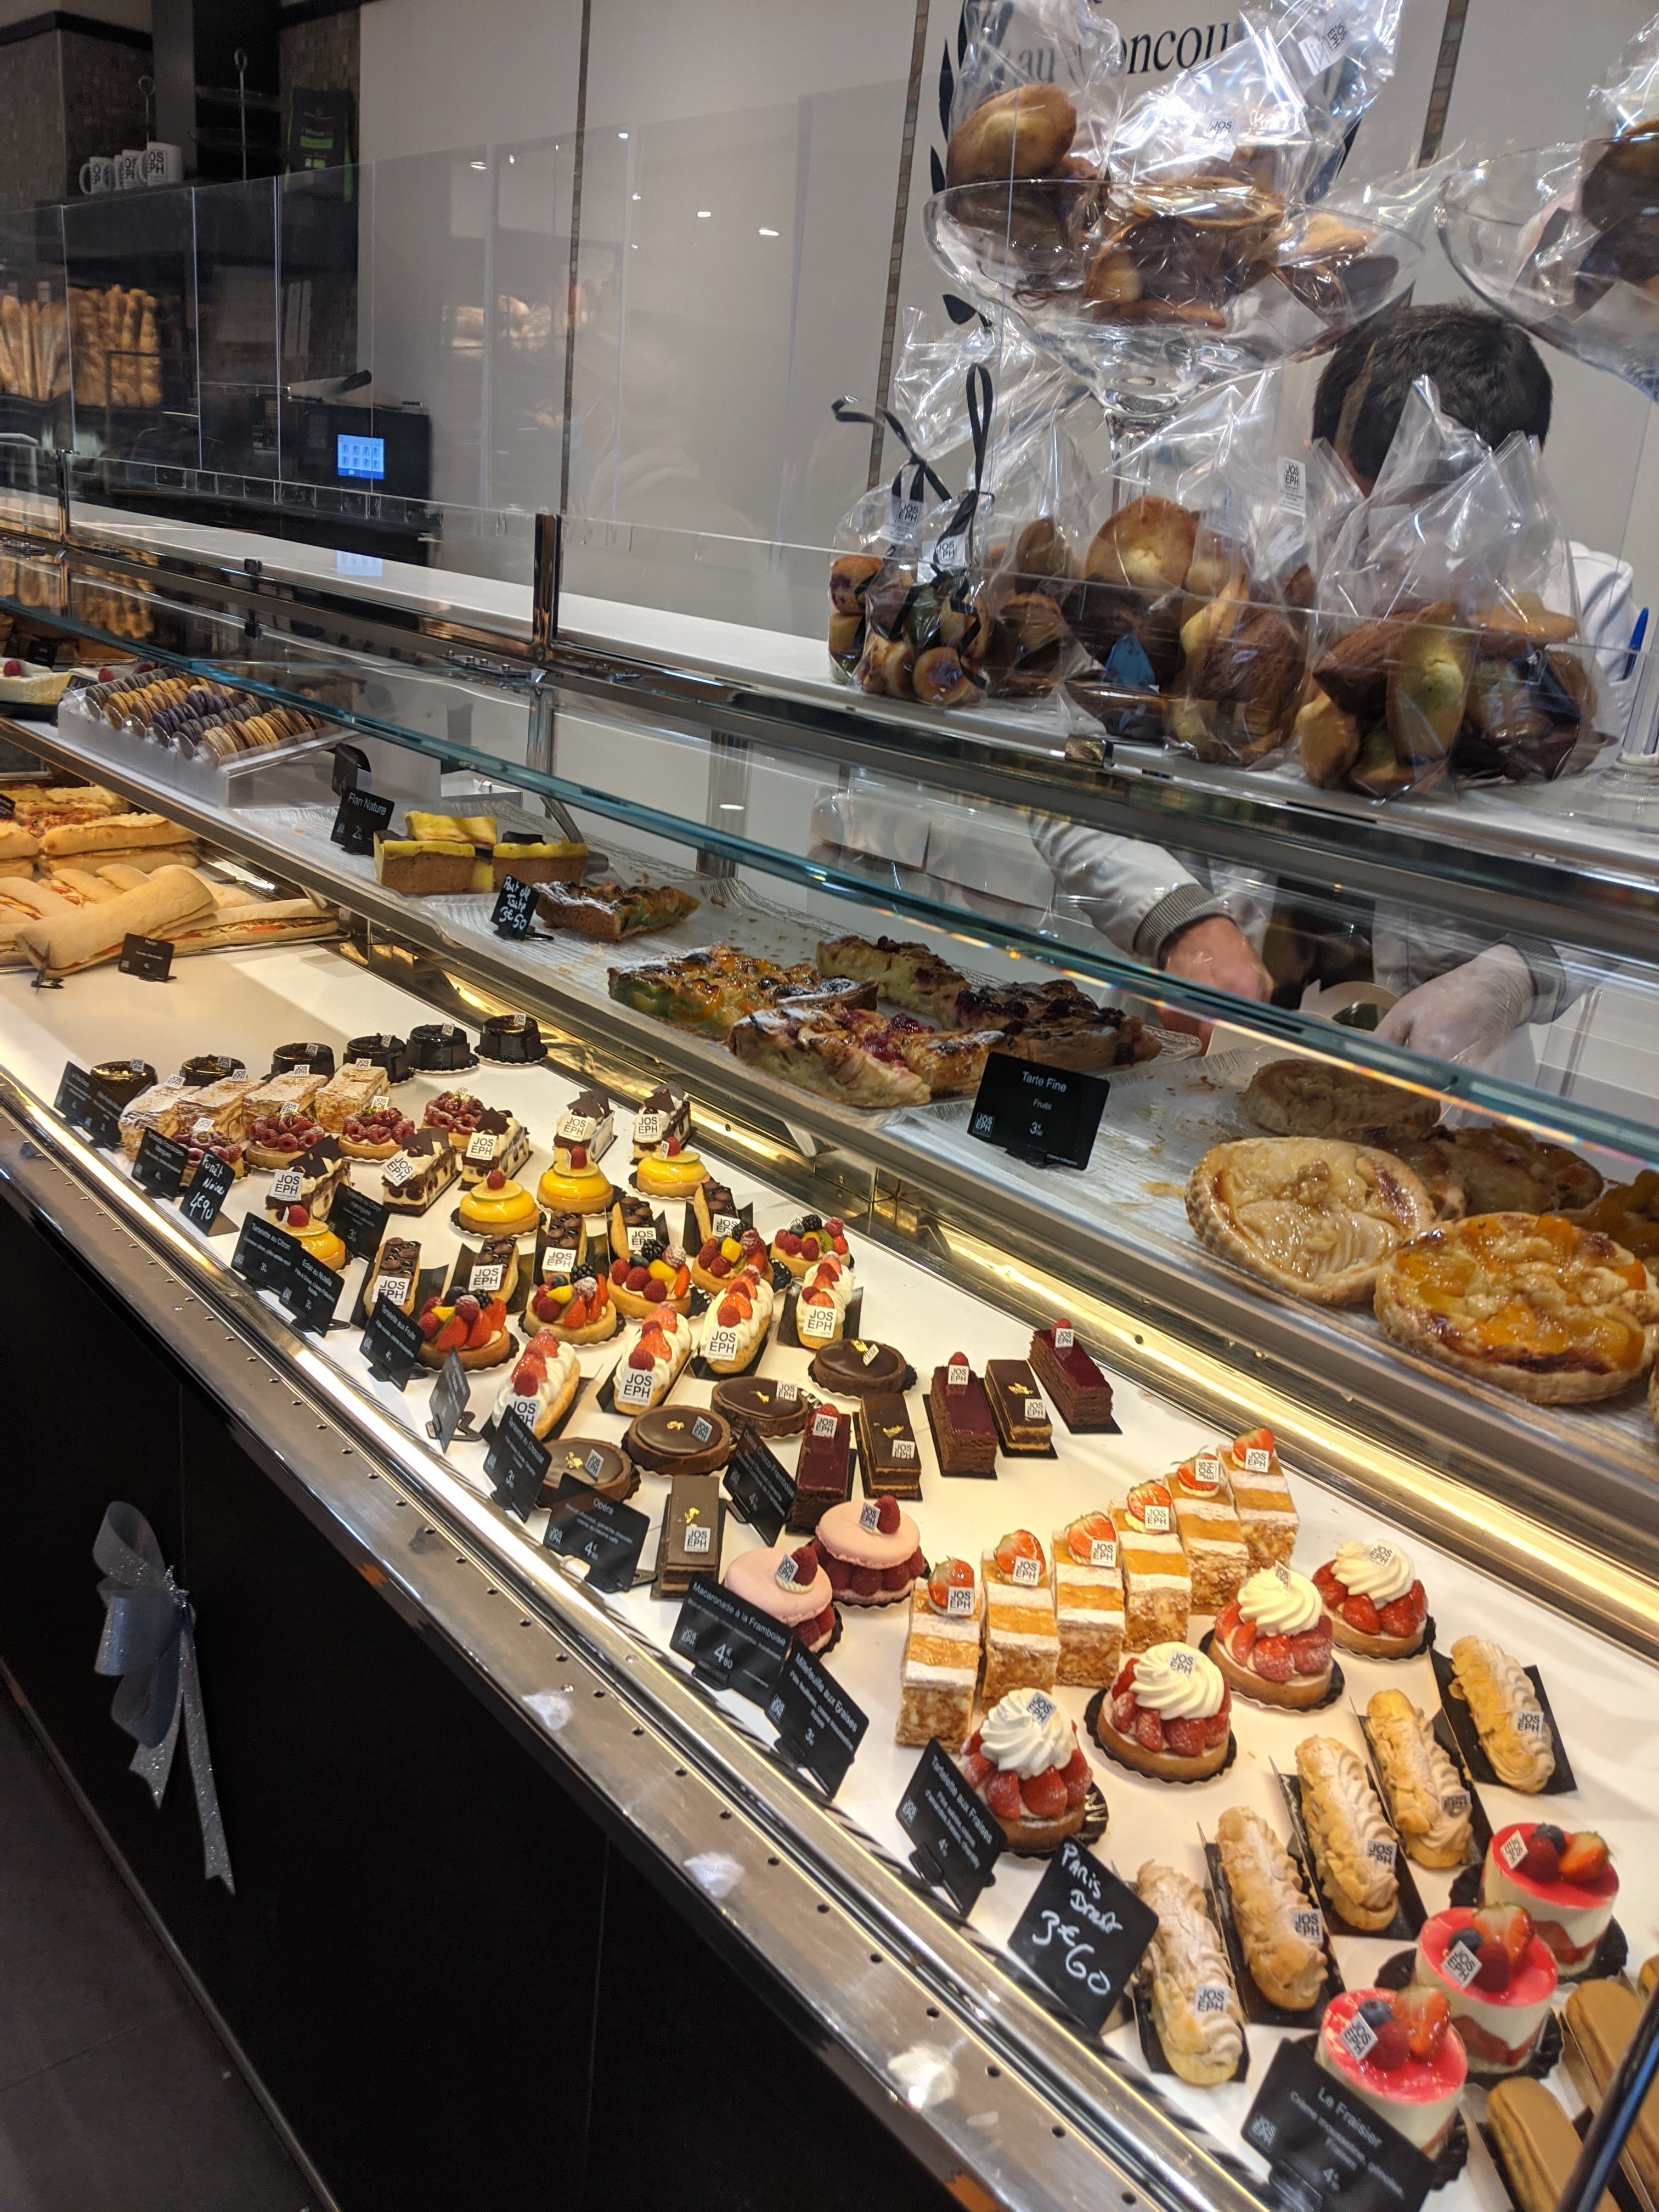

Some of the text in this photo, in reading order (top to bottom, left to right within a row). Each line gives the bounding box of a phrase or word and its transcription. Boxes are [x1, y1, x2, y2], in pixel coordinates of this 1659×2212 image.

[1334, 22, 1348, 40] JOS
[1328, 27, 1345, 49] EPH
[1211, 121, 1233, 129] JOS
[1286, 464, 1299, 476] JOS
[1285, 474, 1299, 487] EPH
[900, 504, 919, 514] JOS
[348, 792, 387, 816] Flan Nature
[1022, 1071, 1066, 1093] Tarte Fine
[1033, 1098, 1052, 1111] Fruits
[567, 1117, 586, 1127] JOS
[639, 1116, 657, 1125] JOS
[978, 1114, 993, 1124] JOS
[563, 1125, 584, 1136] EPH
[639, 1125, 658, 1134] EPH
[473, 1137, 494, 1147] JOS
[471, 1146, 493, 1155] EPH
[387, 1161, 406, 1181] EPH
[395, 1158, 413, 1174] JOS
[277, 1175, 301, 1185] JOS
[275, 1183, 298, 1195] EPH
[251, 1222, 271, 1239] Tartelette
[276, 1237, 291, 1250] Citron
[549, 1251, 572, 1260] JOS
[547, 1259, 571, 1268] EPH
[312, 1267, 319, 1277] au
[318, 1271, 332, 1287] Nutella
[475, 1268, 499, 1277] JOS
[380, 1280, 405, 1290] JOS
[473, 1277, 498, 1285] EPH
[809, 1310, 833, 1321] JOS
[380, 1304, 416, 1341] Tartelette aux Fruits
[808, 1320, 831, 1331] EPH
[712, 1331, 736, 1342] JOS
[709, 1341, 735, 1353] EPH
[626, 1373, 652, 1386] JOS
[624, 1384, 651, 1398] EPH
[779, 1384, 795, 1392] JOS
[778, 1391, 794, 1400] EPH
[1028, 1402, 1043, 1410] JOS
[519, 1414, 535, 1426] PH
[818, 1418, 834, 1427] JOS
[816, 1425, 833, 1434] EPH
[895, 1444, 912, 1452] JOS
[1248, 1451, 1267, 1460] JOS
[1248, 1458, 1266, 1468] EPH
[592, 1496, 614, 1516] Opéra
[862, 1506, 877, 1519] JOS
[1147, 1509, 1166, 1517] JOS
[861, 1514, 876, 1527] EPH
[1147, 1517, 1167, 1525] EPH
[688, 1530, 707, 1539] JOS
[687, 1537, 707, 1547] EPH
[1093, 1543, 1114, 1554] JOS
[1373, 1544, 1393, 1558] JOS
[1093, 1552, 1113, 1561] EPH
[1369, 1551, 1389, 1564] EPH
[1017, 1561, 1037, 1572] JOS
[1015, 1569, 1036, 1581] EPH
[950, 1590, 971, 1600] JOS
[950, 1599, 970, 1609] EPH
[691, 1581, 787, 1647] Macaronade à la Framboise
[1171, 1652, 1194, 1666] JOS
[1170, 1661, 1191, 1675] EPH
[822, 1686, 837, 1707] aux
[1032, 1696, 1052, 1712] JOS
[1026, 1703, 1047, 1723] EPH
[1520, 1714, 1540, 1723] JOS
[1517, 1722, 1539, 1733] EPH
[930, 1754, 994, 1847] Tartelette aux Fraises
[1369, 1844, 1393, 1855] JOS
[1295, 1913, 1319, 1925] JOS
[1454, 1950, 1476, 1971] JOS
[1199, 1989, 1224, 2001] JOS
[1197, 1999, 1223, 2012] EPH
[1316, 2085, 1384, 2150] Le Fraisier
